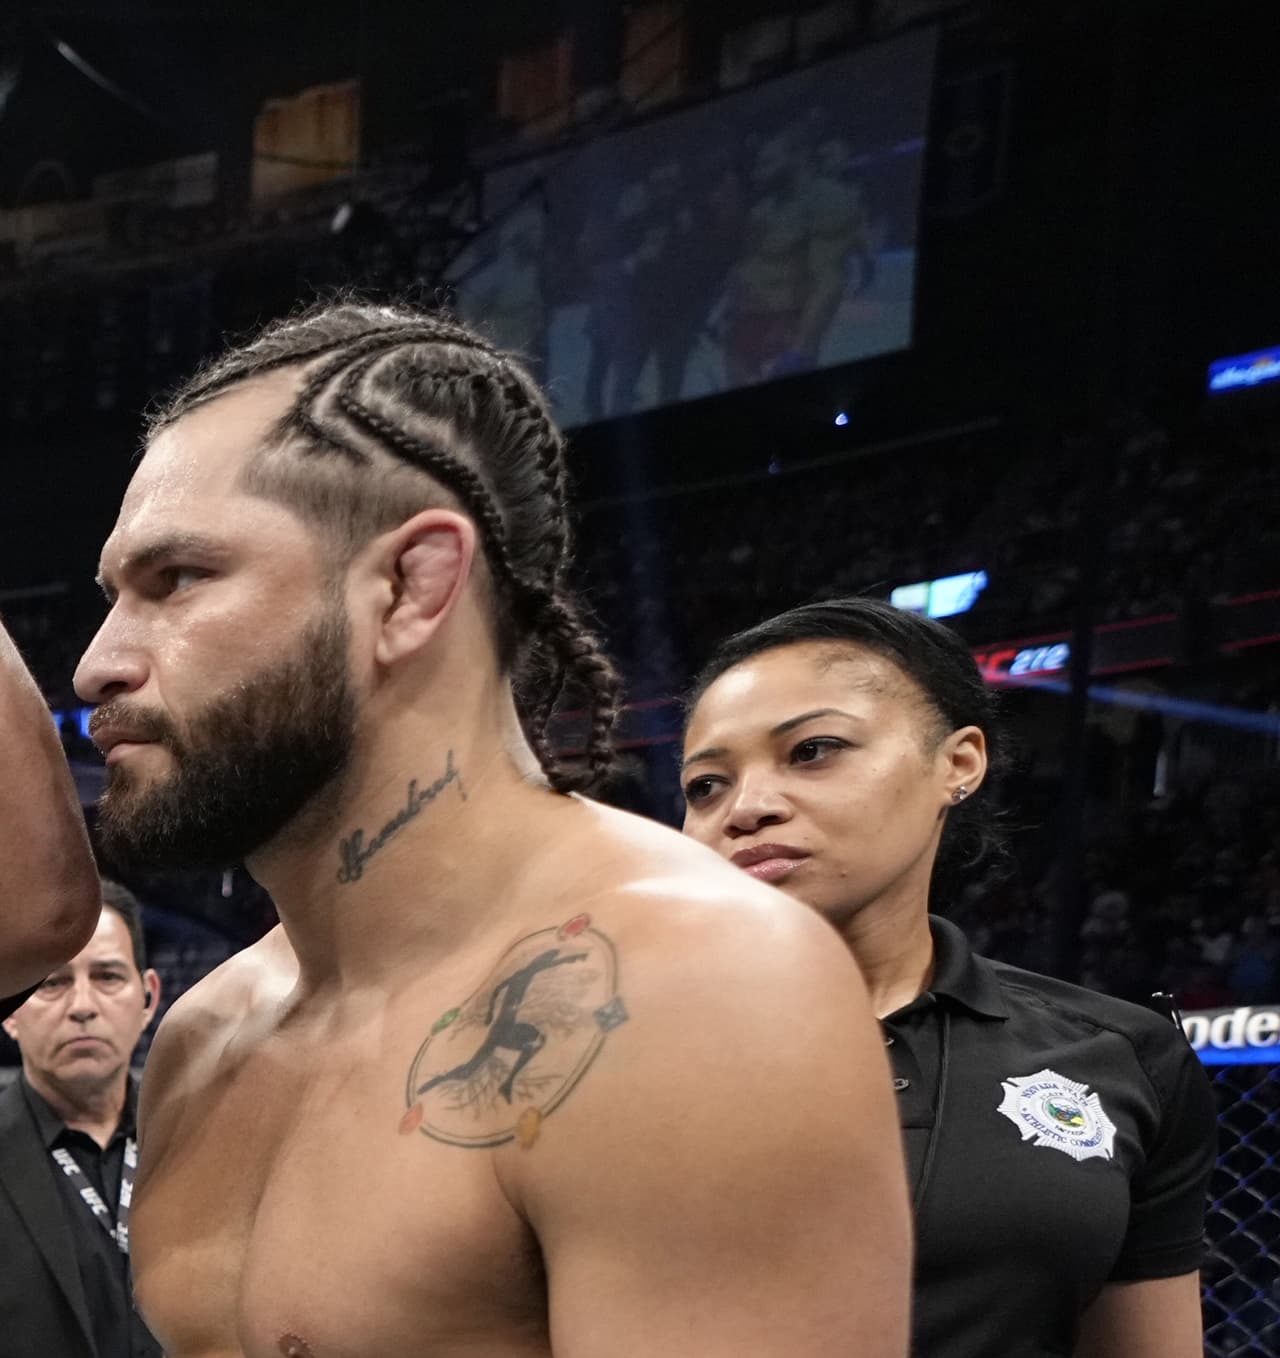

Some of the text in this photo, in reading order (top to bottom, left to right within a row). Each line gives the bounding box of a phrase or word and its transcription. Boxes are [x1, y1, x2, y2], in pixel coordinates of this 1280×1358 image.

[1182, 1007, 1280, 1051] ode
[51, 1147, 81, 1176] UFC
[80, 1186, 108, 1216] UFC
